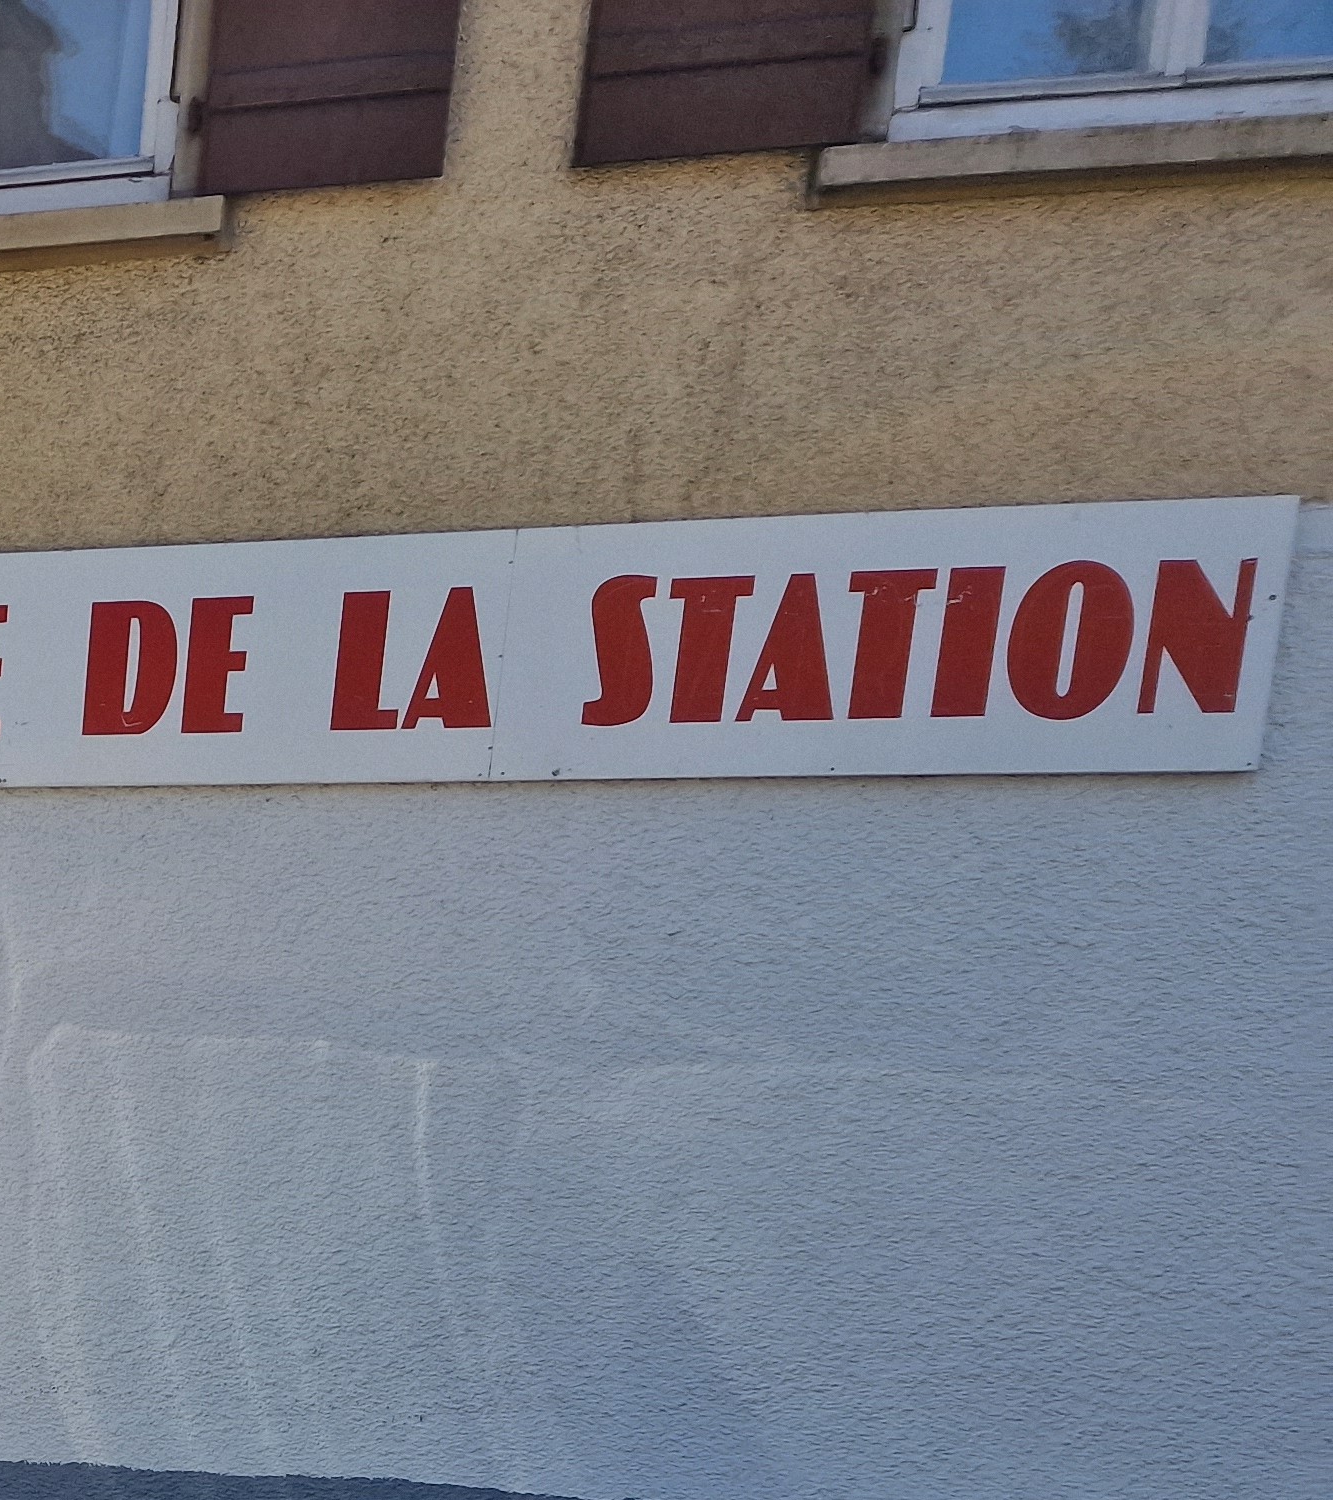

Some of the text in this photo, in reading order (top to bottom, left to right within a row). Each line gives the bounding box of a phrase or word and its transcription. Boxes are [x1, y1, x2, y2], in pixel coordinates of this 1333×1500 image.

[82, 597, 254, 736] DE
[330, 587, 491, 731] LA
[581, 557, 1255, 727] STATION
